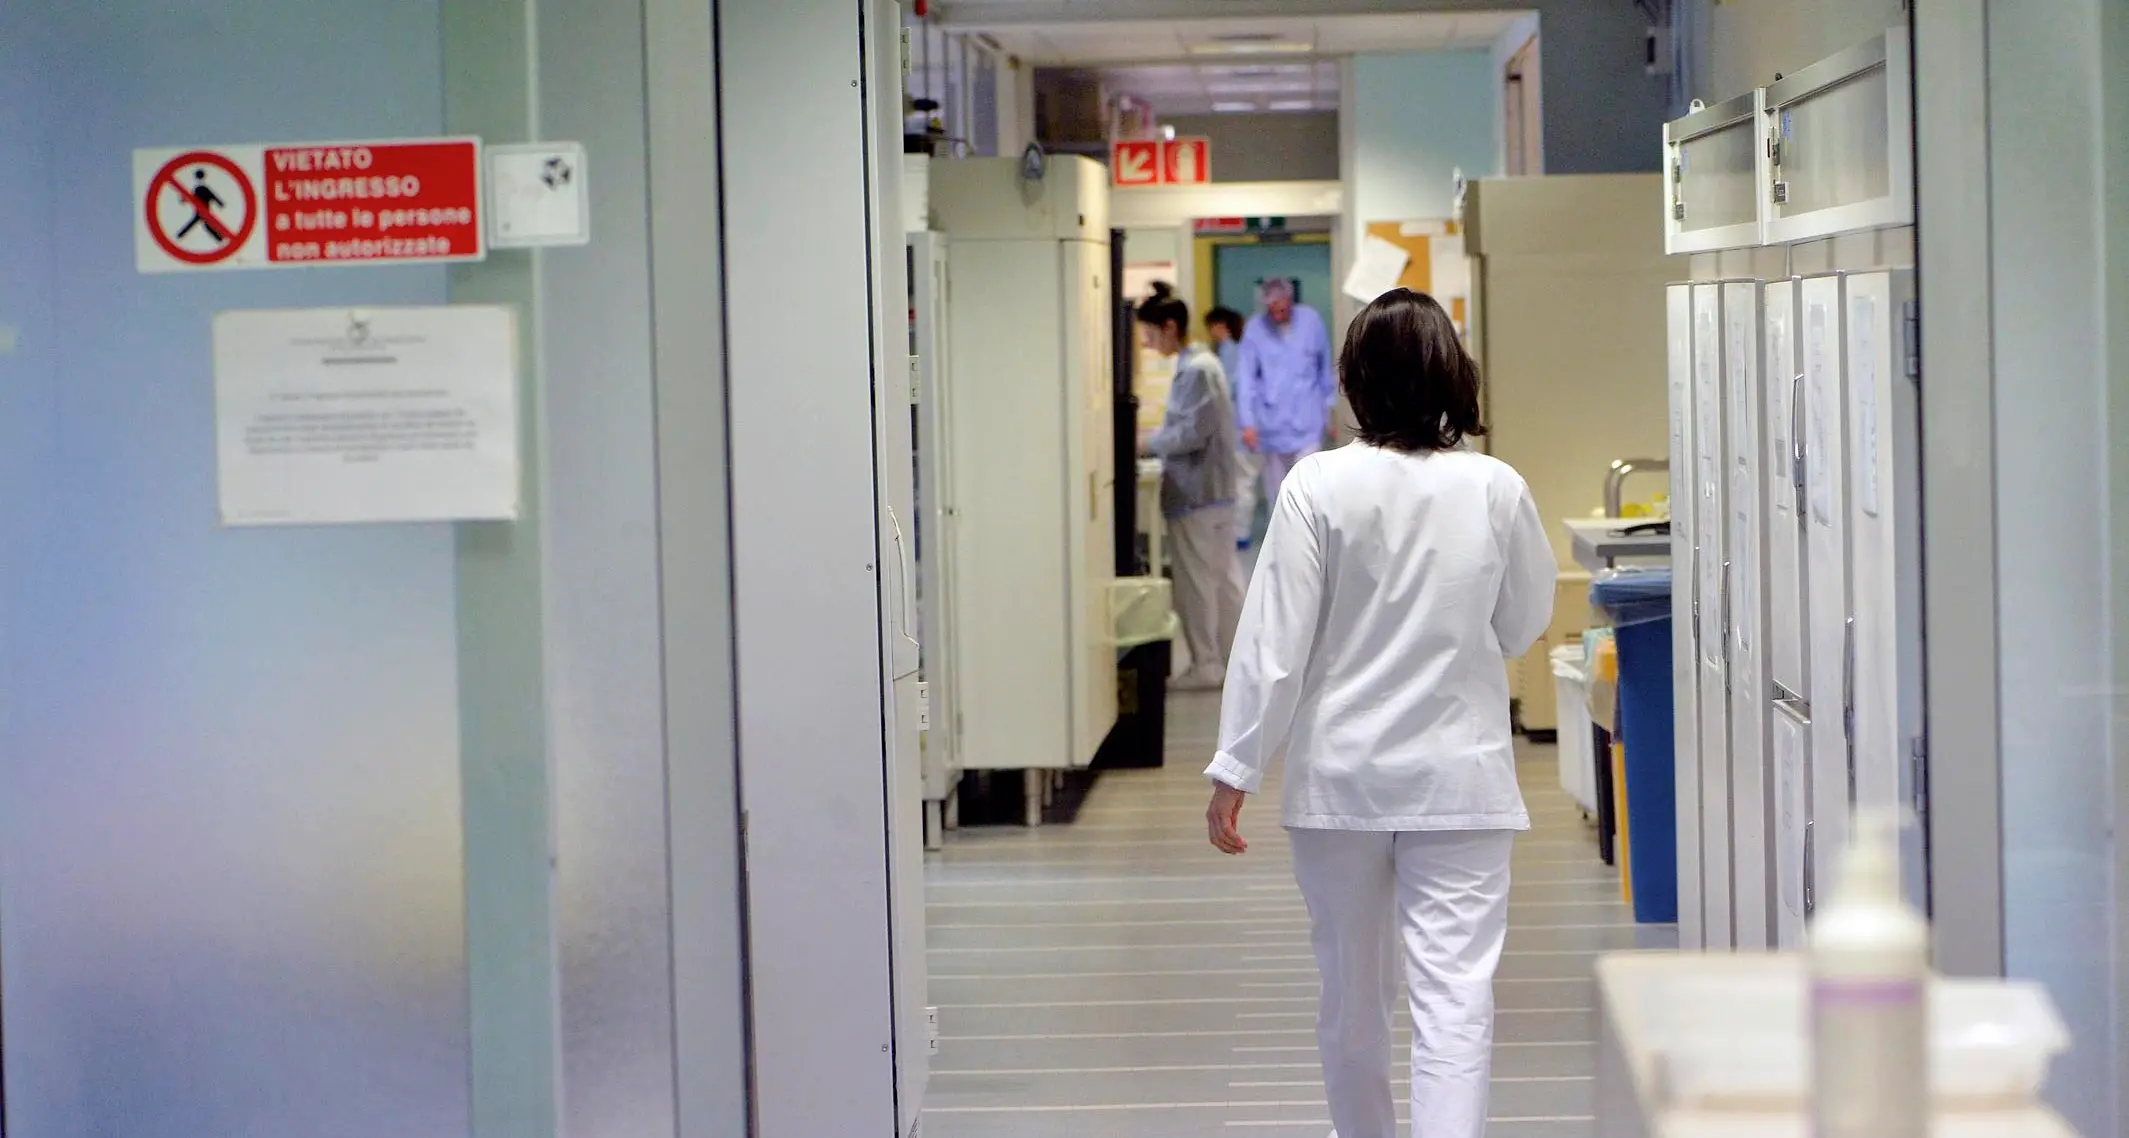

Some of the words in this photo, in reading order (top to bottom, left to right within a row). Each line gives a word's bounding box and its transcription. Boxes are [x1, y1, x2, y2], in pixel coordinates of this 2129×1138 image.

[273, 147, 372, 171] VIETATO
[274, 175, 420, 201] L'INGRESSO
[275, 213, 290, 231] a
[295, 208, 348, 230] tutte
[352, 206, 375, 228] le
[378, 207, 472, 231] persone
[277, 241, 320, 259] non
[325, 235, 450, 258] autorizzate
